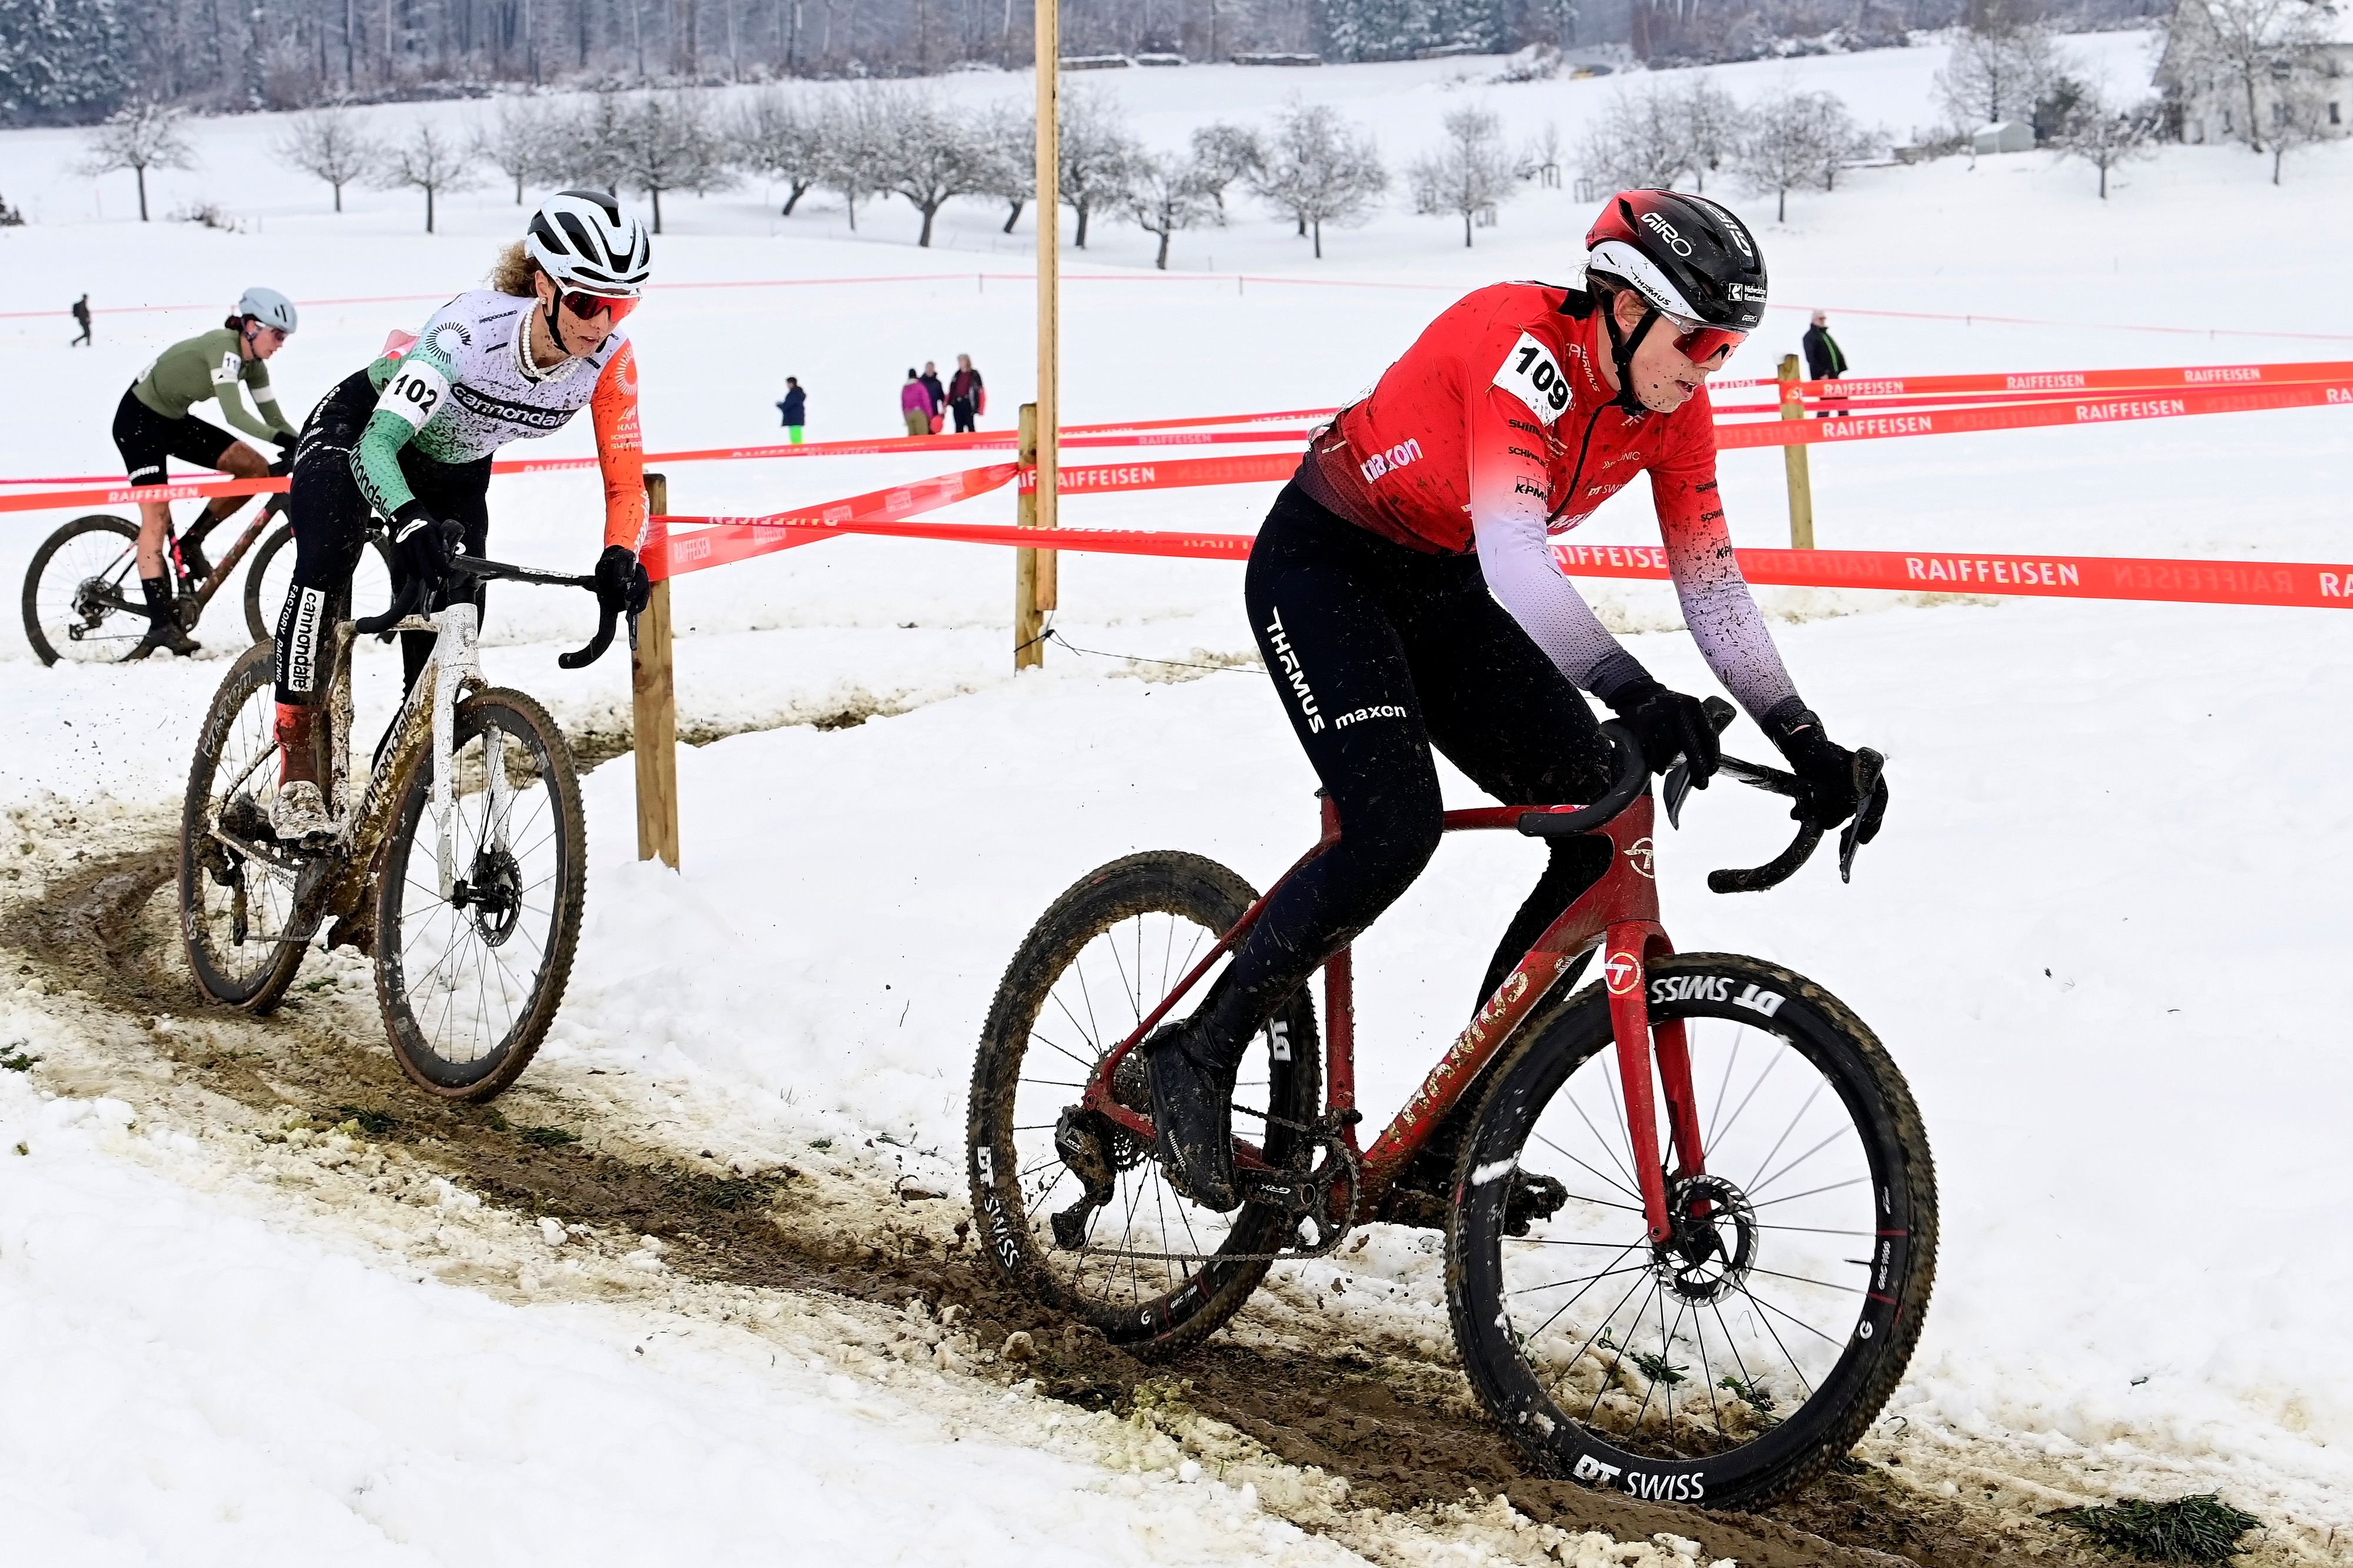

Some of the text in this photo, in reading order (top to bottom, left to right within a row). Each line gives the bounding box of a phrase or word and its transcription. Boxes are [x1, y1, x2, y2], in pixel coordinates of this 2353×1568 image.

[1640, 212, 1692, 256] GIRO
[1516, 347, 1568, 410] 109
[2007, 375, 2085, 389] RAIFFEISEN
[2184, 368, 2261, 382] RAIFFEISEN
[394, 374, 438, 415] 102
[1824, 381, 1904, 396] RAIFFEISEN
[454, 385, 573, 427] cannondale
[2076, 399, 2185, 421] RAIFFEISEN
[1822, 416, 1932, 438] RAIFFEISEN
[1138, 434, 1212, 445] RAIFFEISEN
[1058, 466, 1155, 488] AIFFEISEN
[108, 487, 199, 502] RAIFFEISEN
[1602, 483, 1627, 495] SWI
[1551, 546, 1667, 569] AIFFEISE
[1715, 545, 1733, 560] KP
[1905, 556, 2080, 587] RAIFFEISEN
[275, 584, 298, 682] FACTORY RACING
[294, 592, 316, 690] cannondale
[1335, 705, 1408, 729] maxon
[1651, 975, 1787, 1017] DT SWISS
[1168, 1129, 1187, 1167] SHIMANO
[1572, 1453, 1704, 1500] DT SWISS
